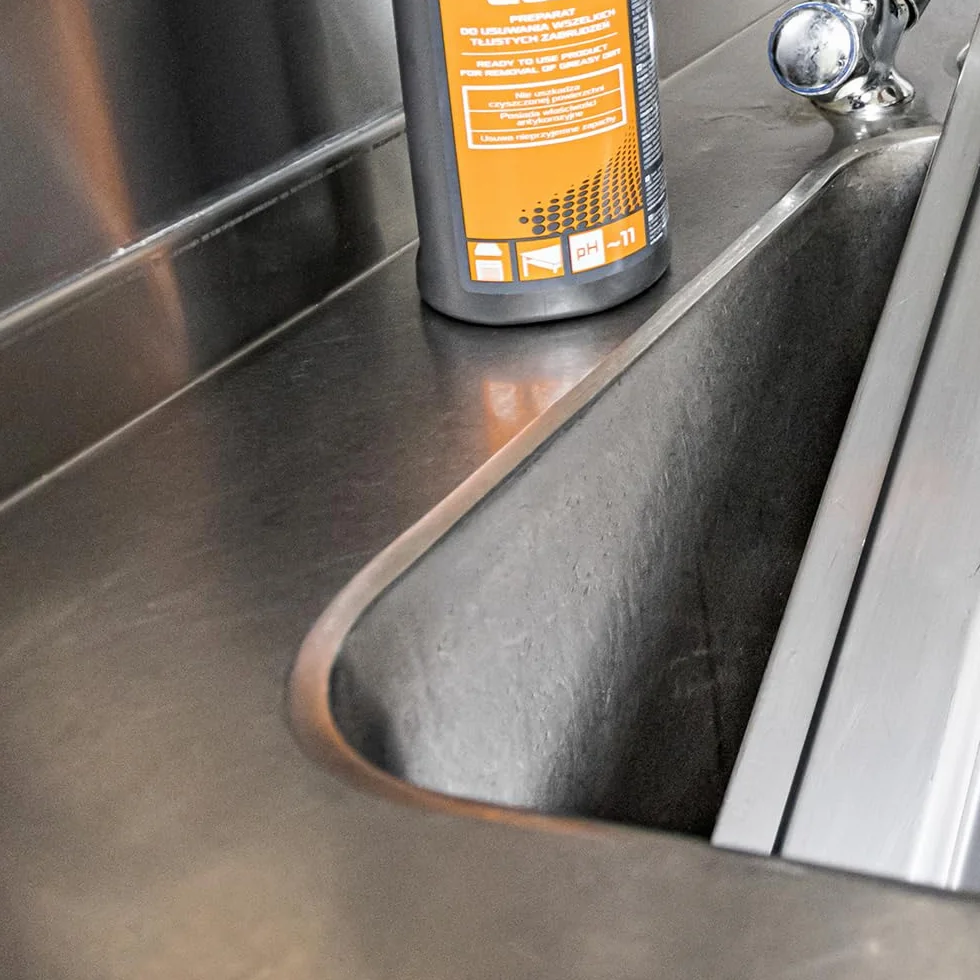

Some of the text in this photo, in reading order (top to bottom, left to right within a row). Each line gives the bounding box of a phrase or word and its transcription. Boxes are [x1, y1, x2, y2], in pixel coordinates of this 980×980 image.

[460, 8, 616, 36] DO USUWANIA WSZELKICH
[509, 8, 576, 24] PREPARAT
[470, 36, 538, 47] TŁUSTYCH
[460, 69, 483, 77] FOR
[485, 67, 540, 77] REMOVAL
[541, 64, 557, 73] OF
[559, 55, 601, 70] GREASY
[476, 43, 608, 68] READY TO USE PRODUCT
[515, 91, 532, 99] Nie
[576, 240, 599, 261] pH
